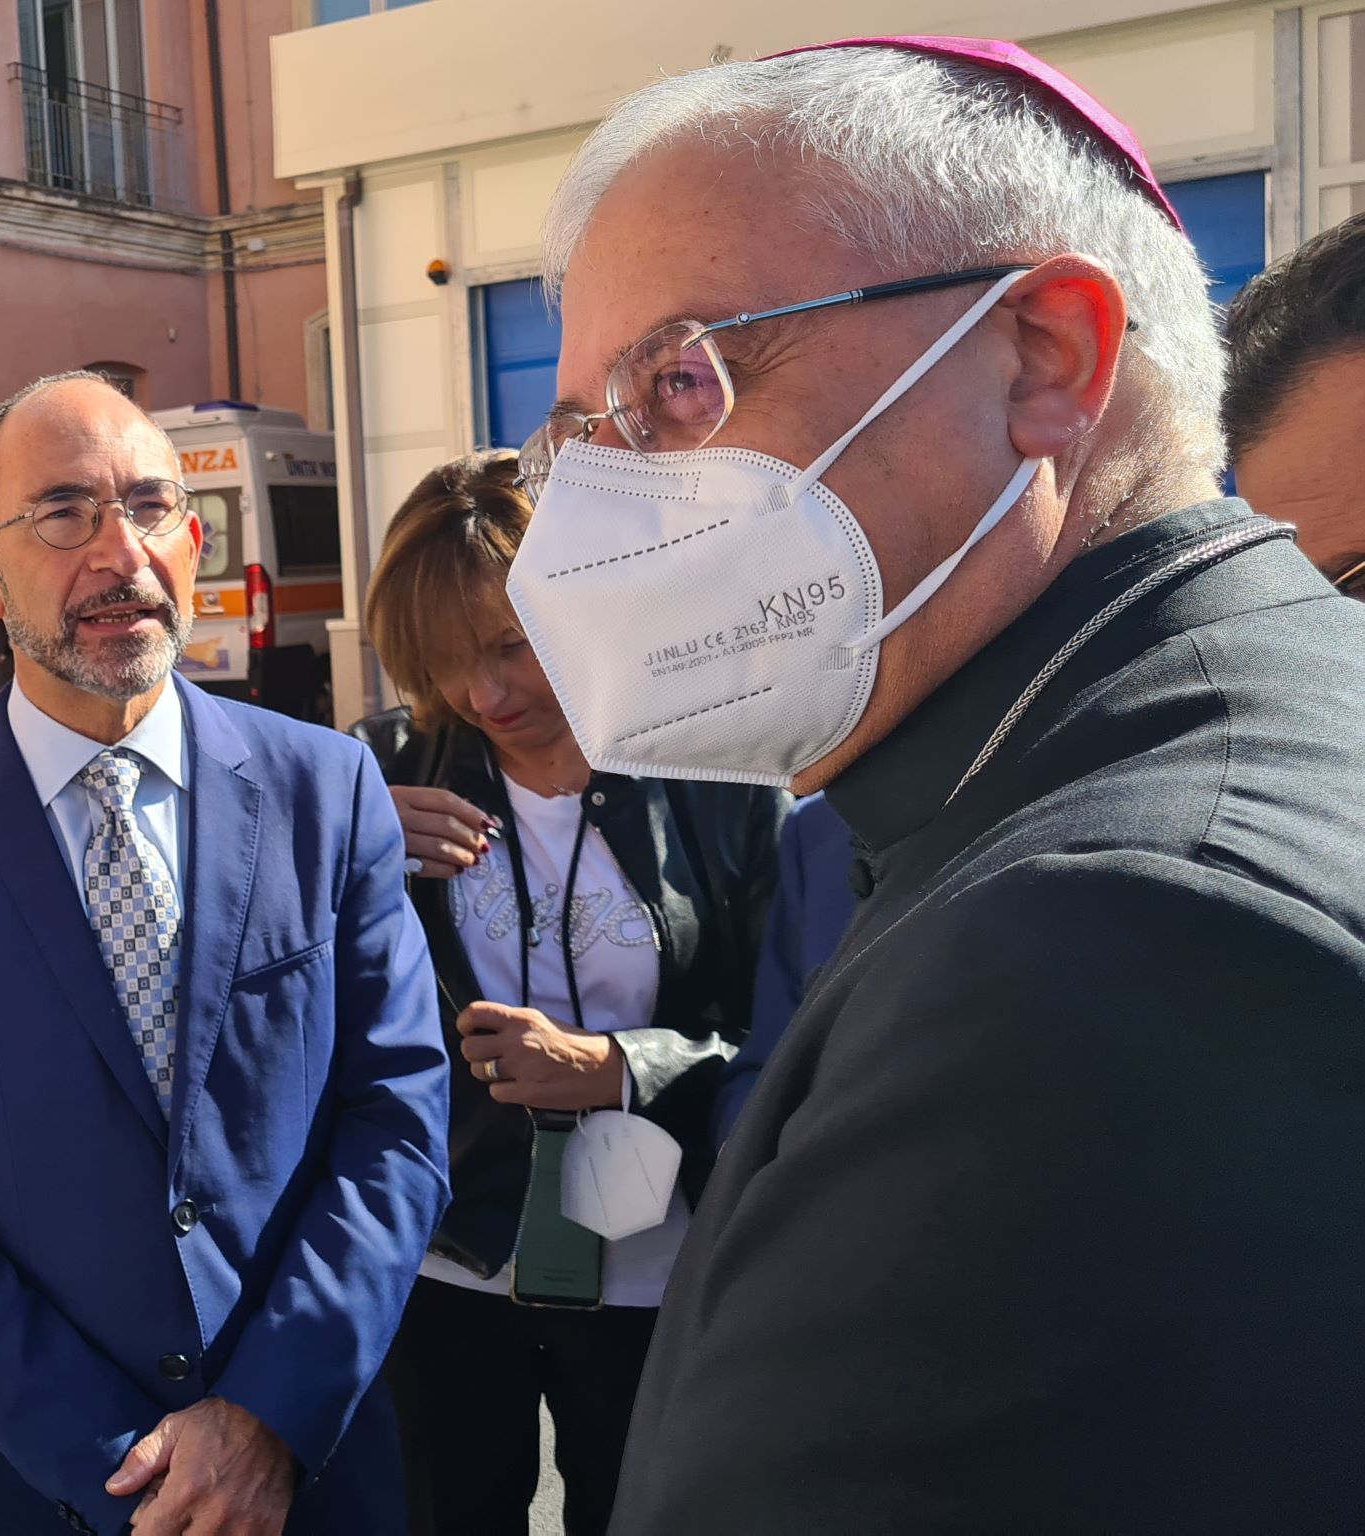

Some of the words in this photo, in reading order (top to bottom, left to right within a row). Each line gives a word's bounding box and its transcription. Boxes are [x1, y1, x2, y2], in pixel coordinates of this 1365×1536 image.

[758, 575, 845, 622] KN95
[643, 639, 698, 667] JINLU
[704, 631, 726, 649] CE
[732, 620, 768, 640] 2163
[775, 608, 816, 631] KN95
